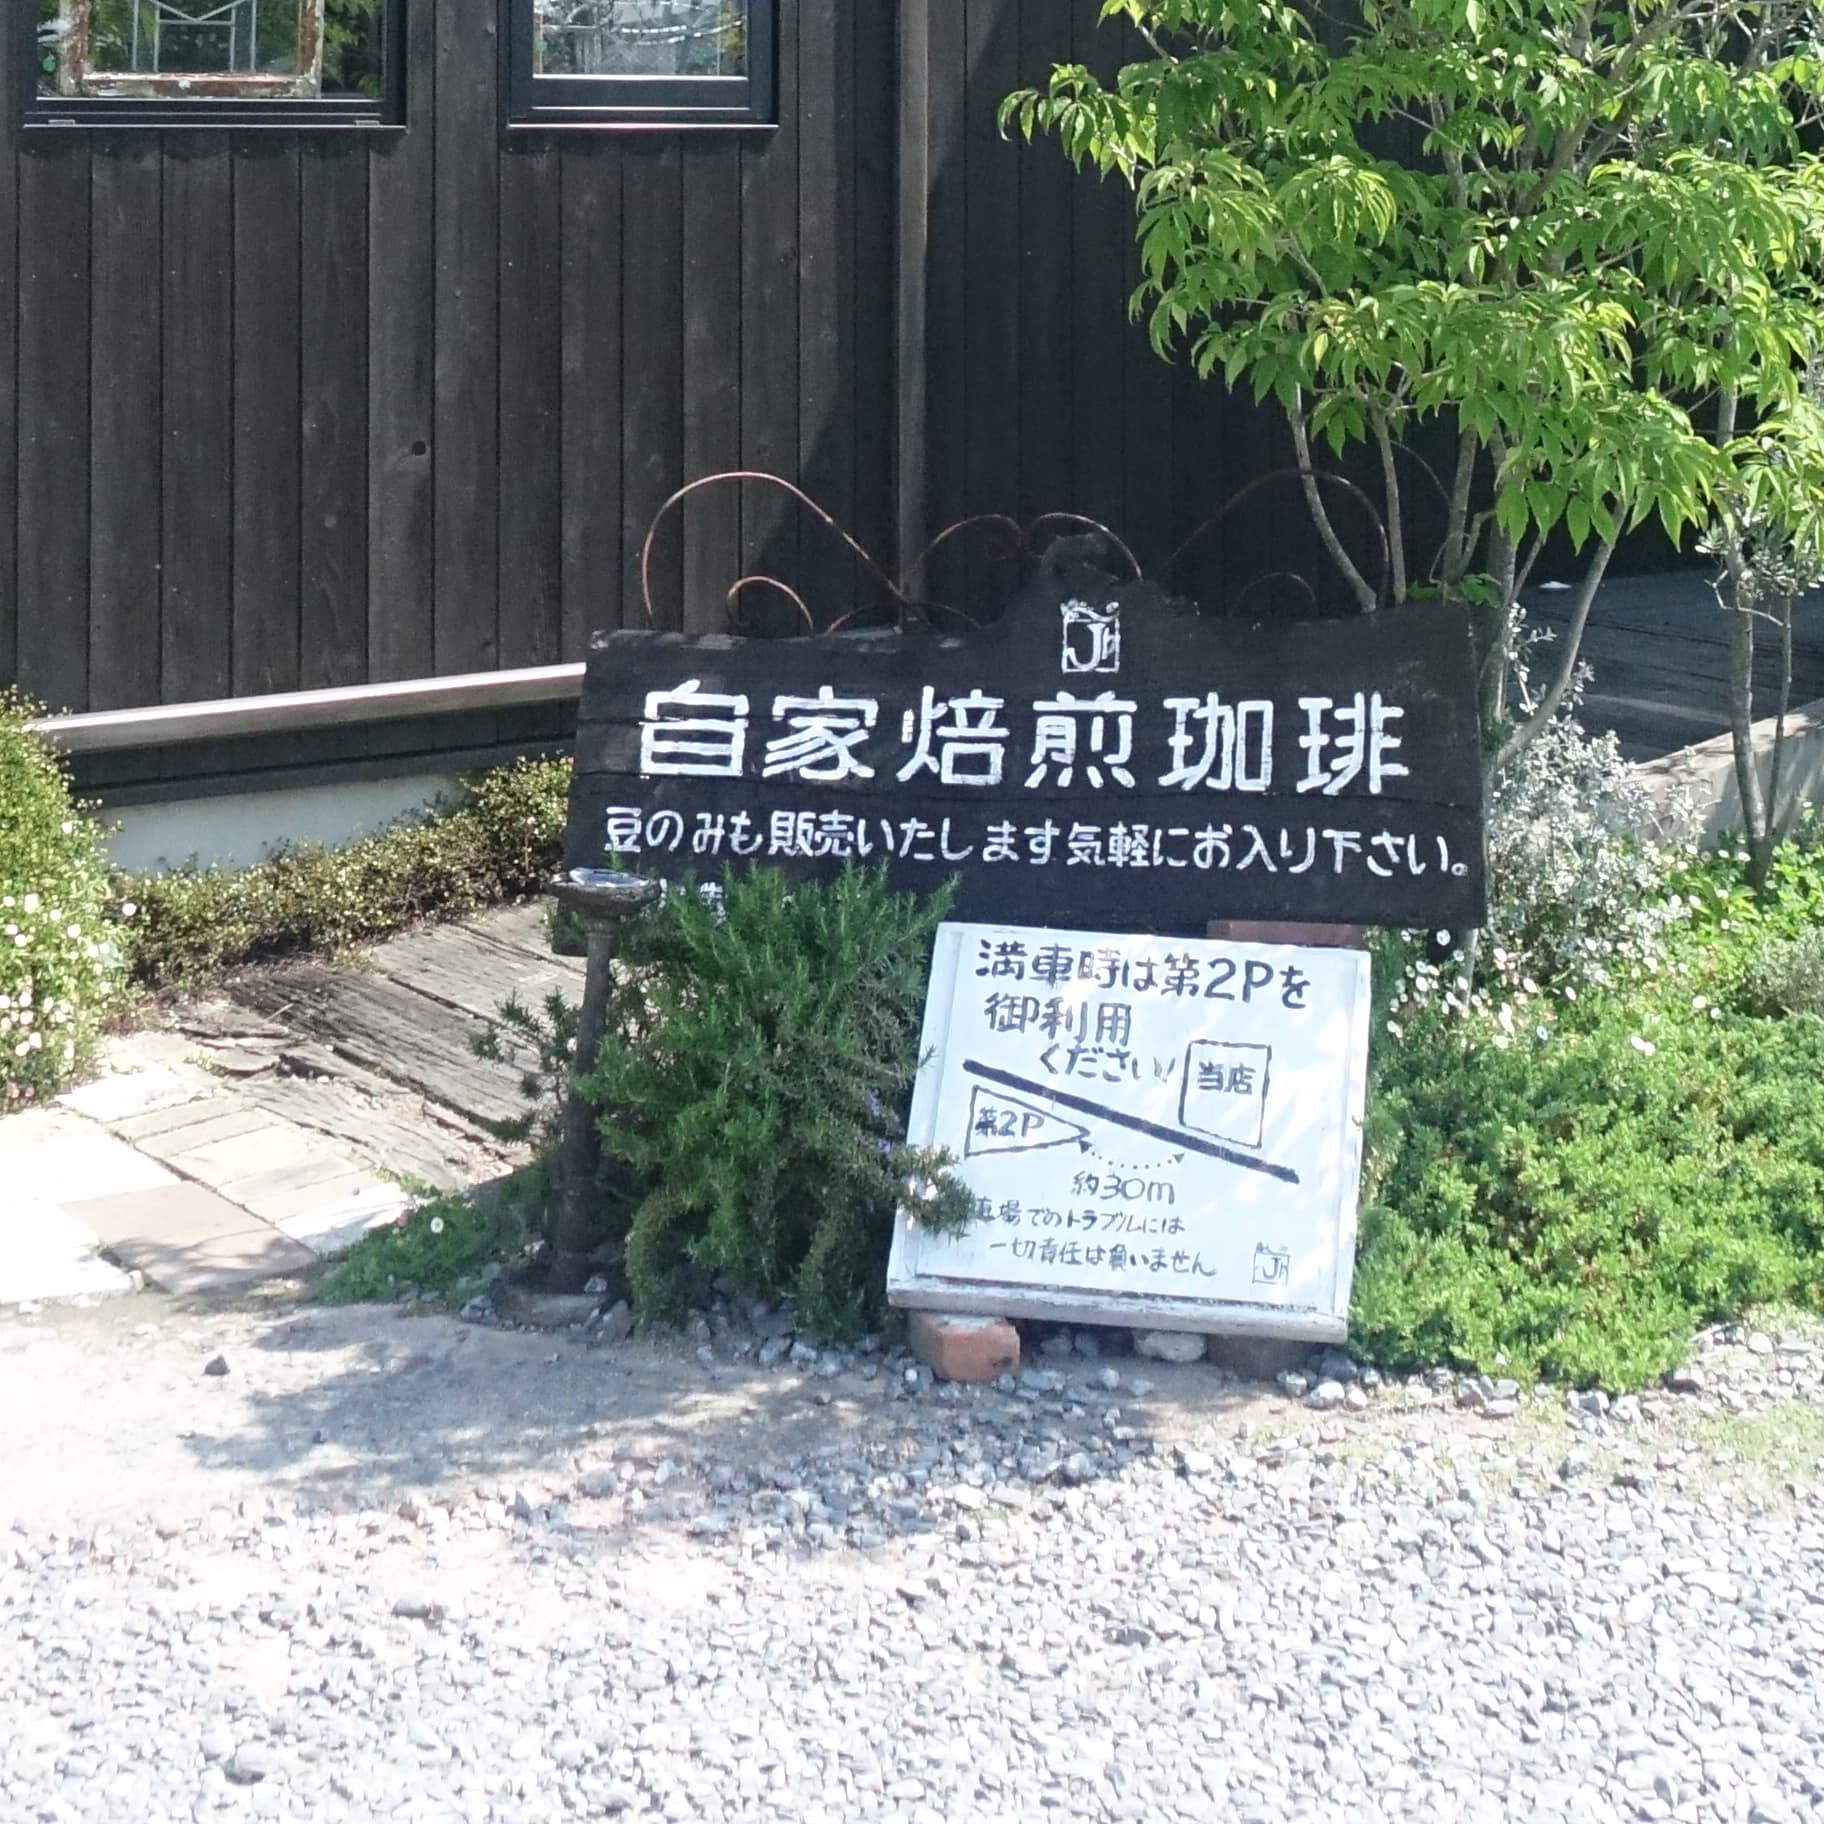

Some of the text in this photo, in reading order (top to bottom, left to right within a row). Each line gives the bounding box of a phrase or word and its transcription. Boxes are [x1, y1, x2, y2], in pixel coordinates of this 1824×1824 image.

[638, 678, 1410, 797] 自家焙煎珈琲
[983, 991, 1132, 1047] 御利用
[1197, 1060, 1257, 1095] 当店
[974, 1106, 1046, 1139] 第2P
[1072, 1170, 1176, 1205] 約30m
[988, 1237, 1218, 1278] 一切責任は負いません
